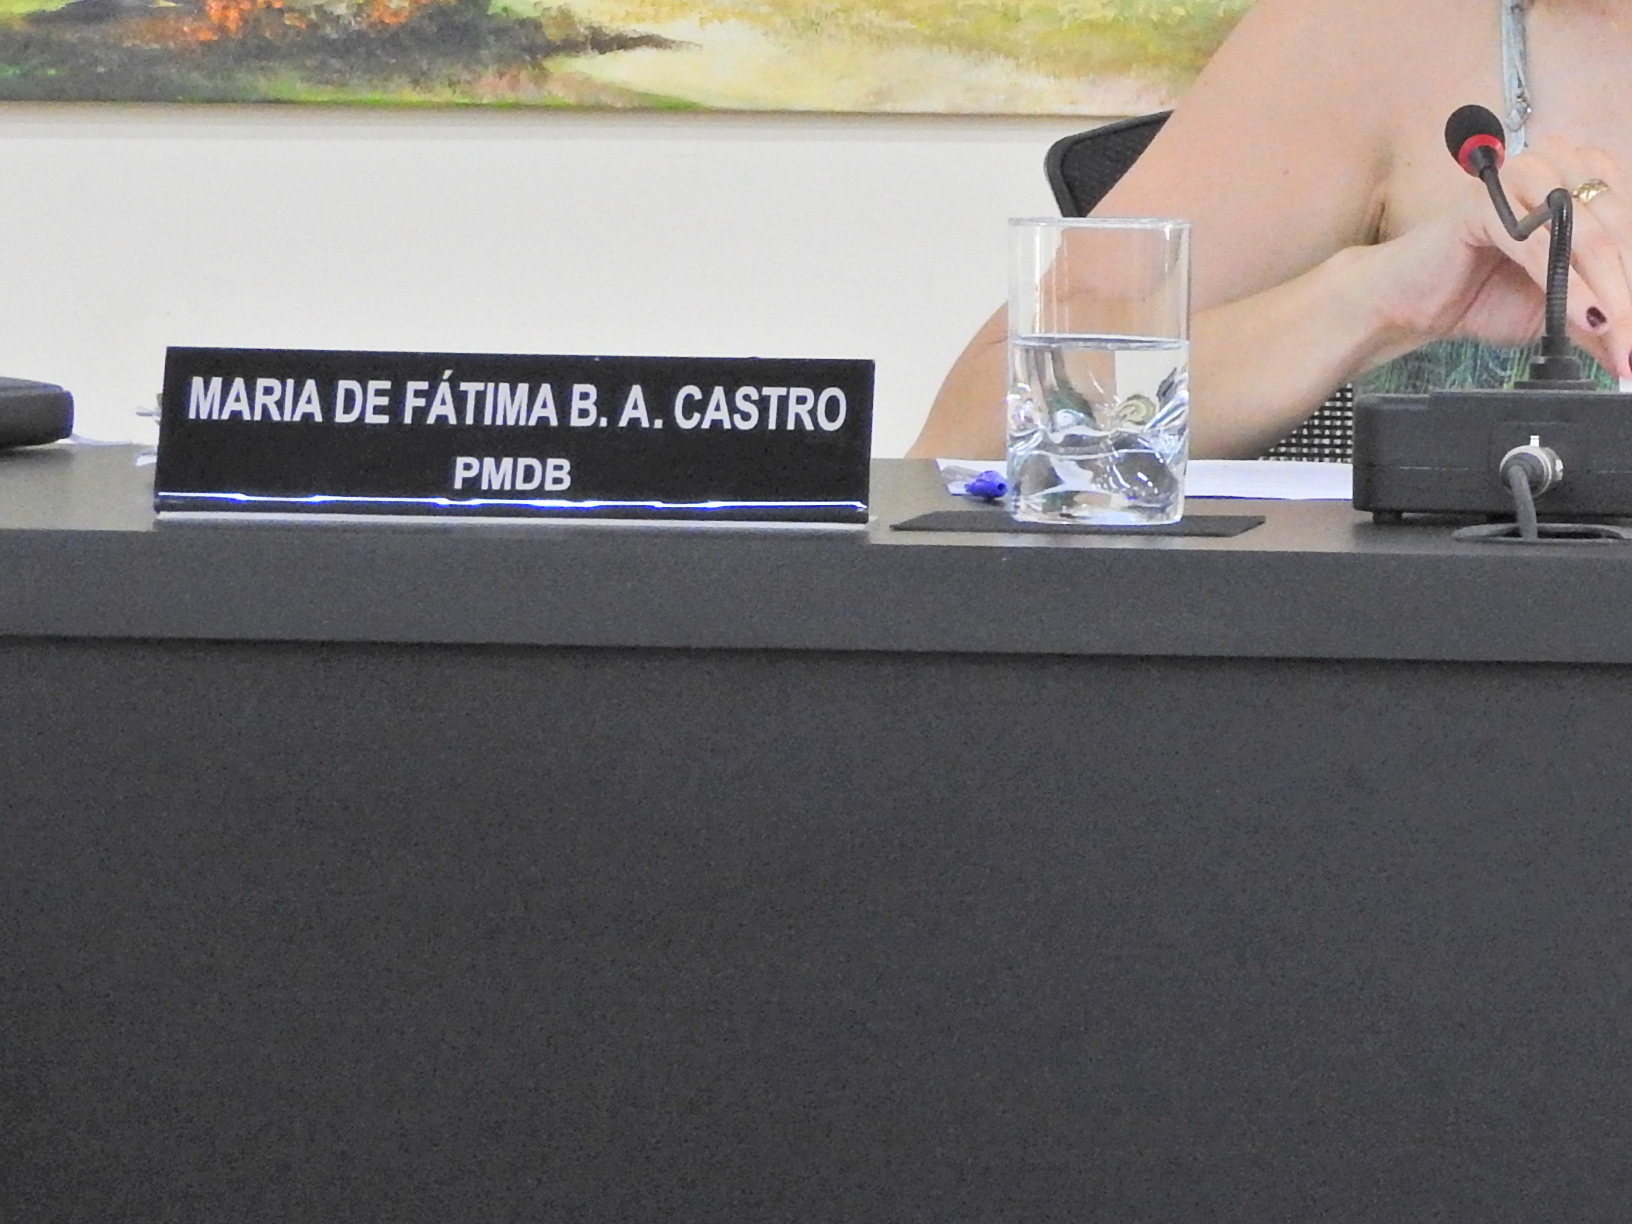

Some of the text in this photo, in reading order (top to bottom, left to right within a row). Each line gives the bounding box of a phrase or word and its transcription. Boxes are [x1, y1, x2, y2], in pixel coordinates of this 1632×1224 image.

[188, 369, 847, 432] MARIA DE FÁTIMA B. A. CASTRO
[453, 456, 572, 491] PMDB
